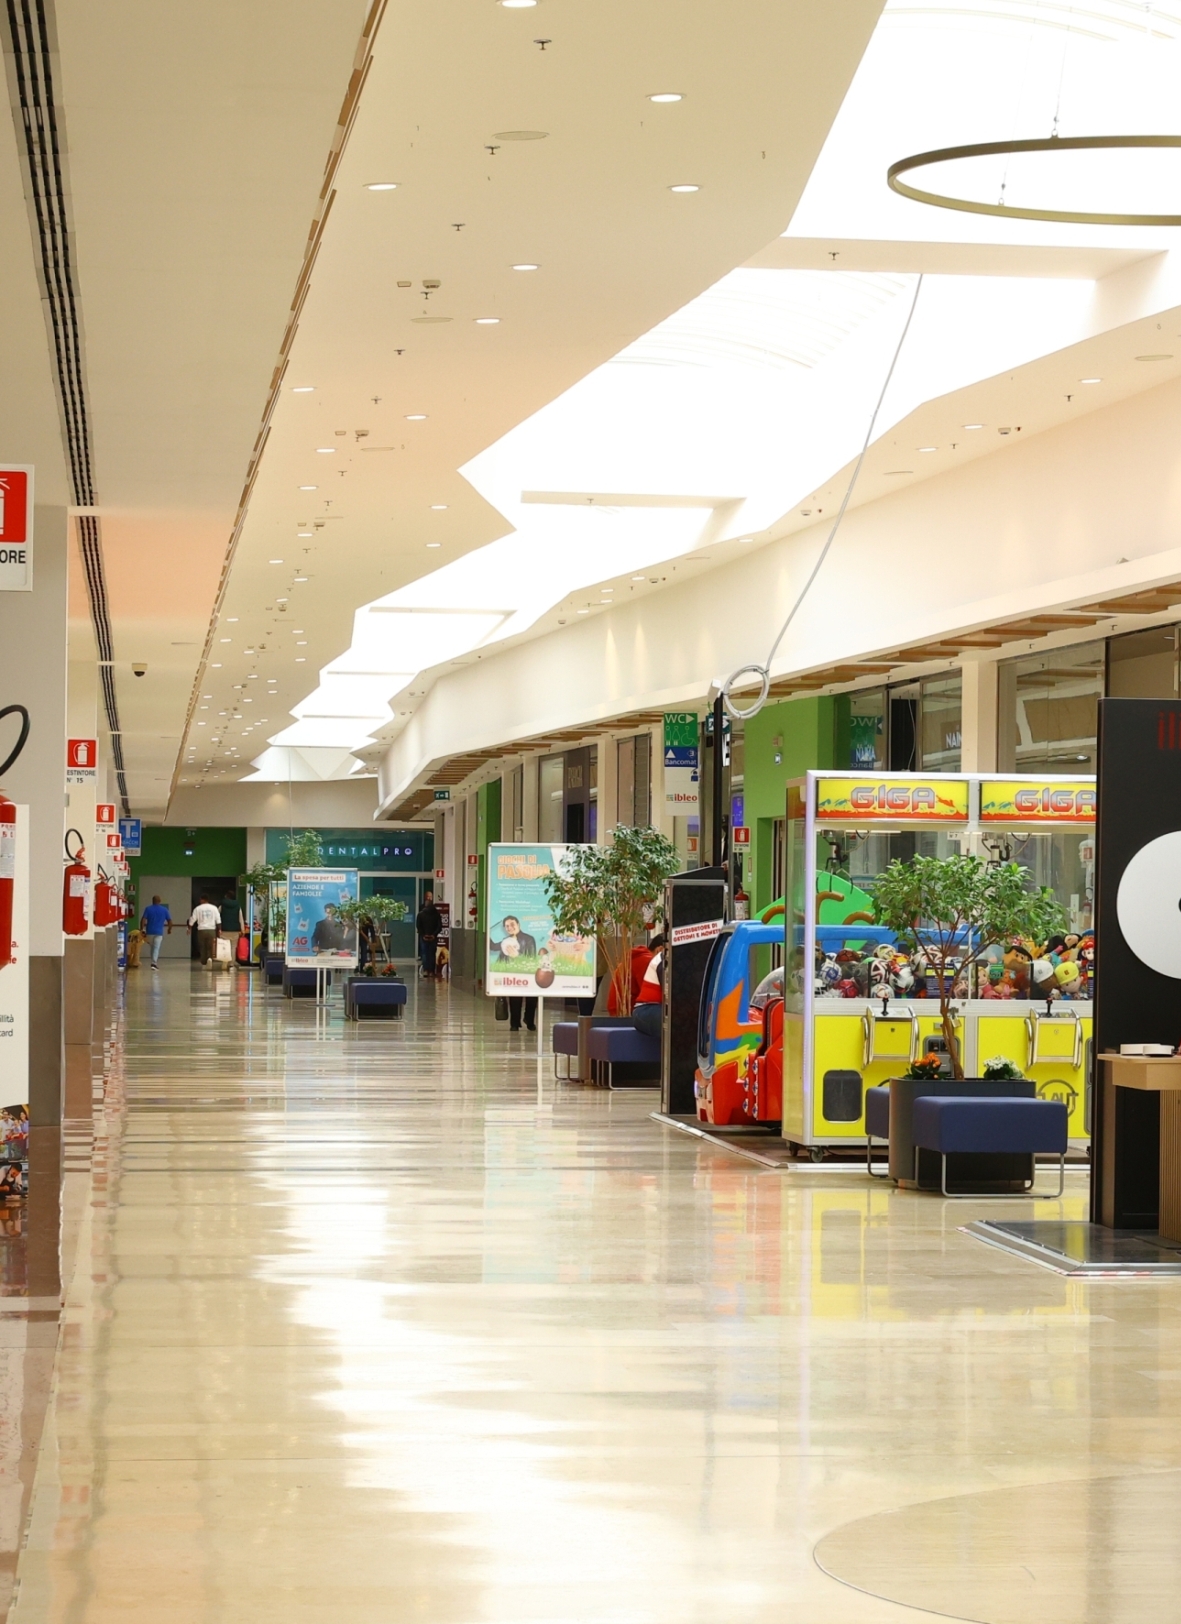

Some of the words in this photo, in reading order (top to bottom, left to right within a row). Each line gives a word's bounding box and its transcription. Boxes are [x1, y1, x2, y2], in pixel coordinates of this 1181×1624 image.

[665, 713, 686, 724] WC
[665, 758, 697, 766] Bancomat
[674, 793, 698, 802] ibleo
[850, 784, 937, 814] GIGA
[1014, 787, 1097, 816] GIGA
[498, 855, 526, 865] GIOCHI
[528, 855, 537, 864] DI
[497, 864, 551, 881] PASQUA
[674, 924, 711, 936] DISTRIBUTORE
[292, 936, 308, 946] AG
[673, 934, 695, 943] GETTONI
[503, 977, 529, 986] ibleo
